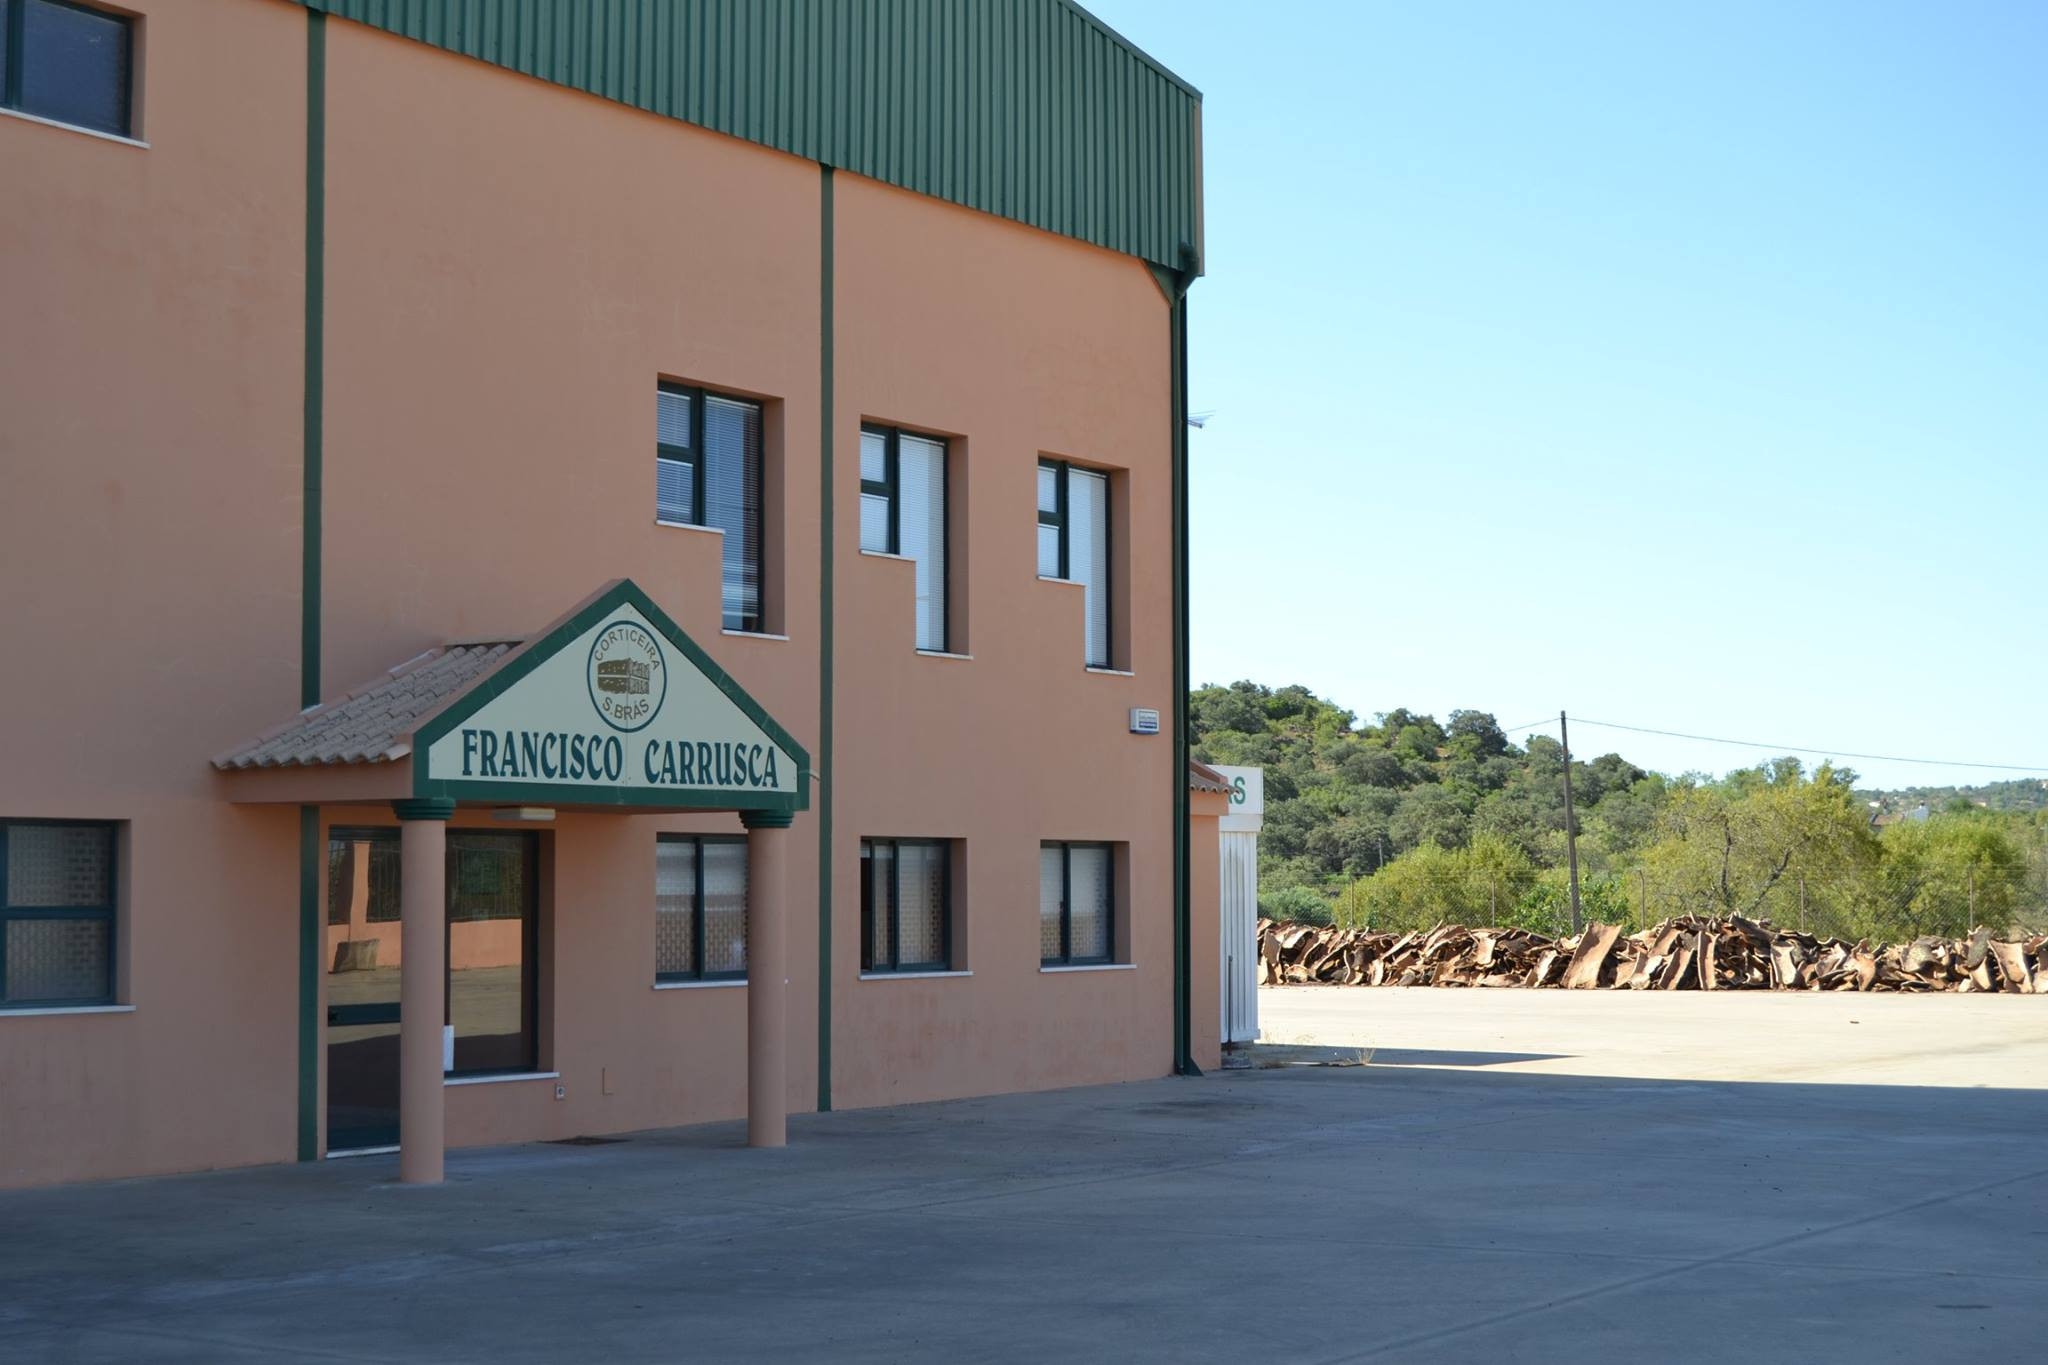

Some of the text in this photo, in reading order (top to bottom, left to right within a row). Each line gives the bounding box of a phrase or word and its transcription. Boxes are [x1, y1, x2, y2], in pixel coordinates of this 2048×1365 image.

[595, 628, 660, 671] CORTICEIRA
[462, 729, 778, 788] FRANCISCO CARRUSCA
